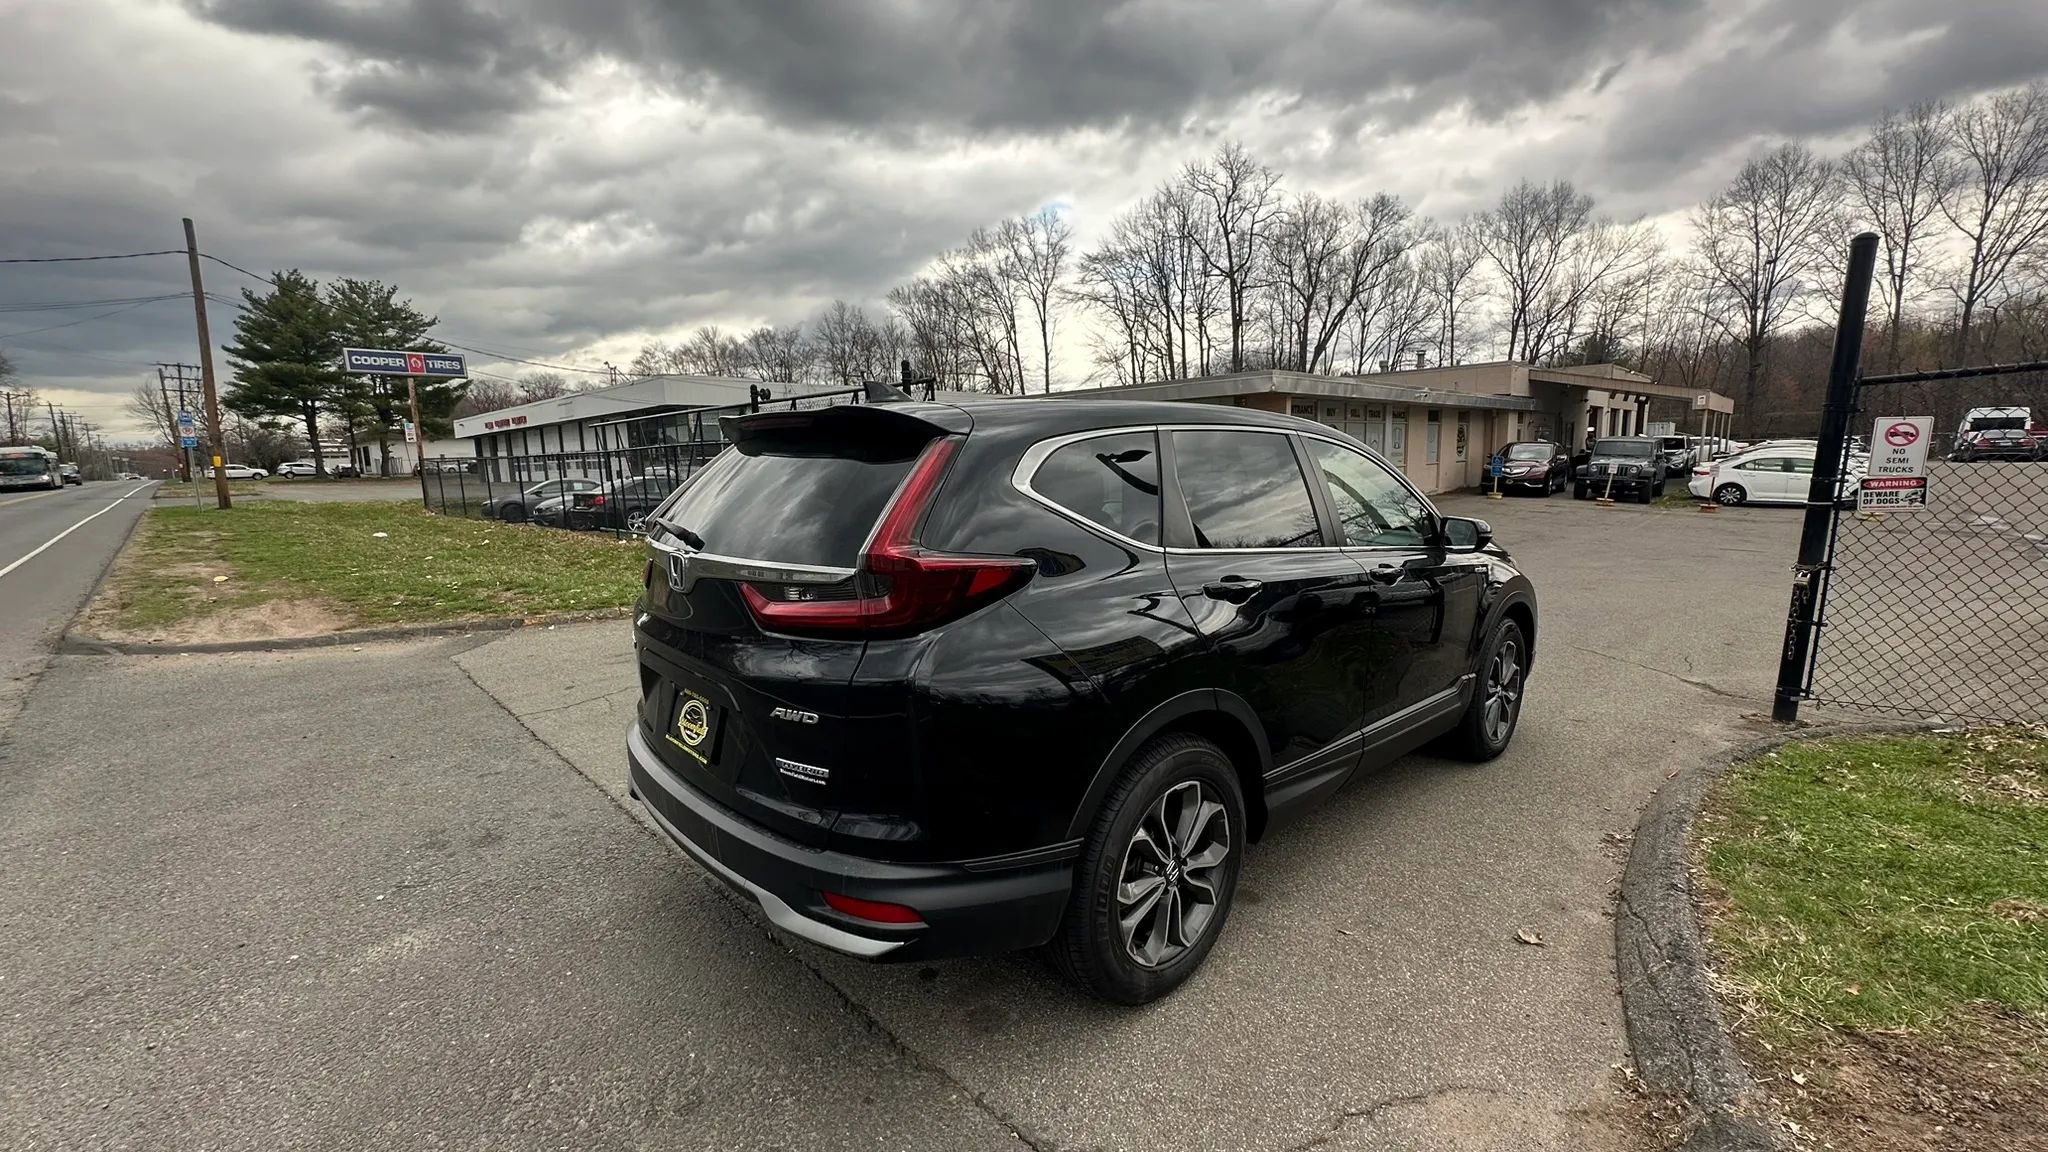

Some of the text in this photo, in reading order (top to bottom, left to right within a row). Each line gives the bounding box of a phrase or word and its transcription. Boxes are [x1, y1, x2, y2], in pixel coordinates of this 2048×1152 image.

[351, 355, 460, 370] COOPER TIRES
[1869, 480, 1917, 488] WARNING
[769, 707, 819, 725] AWD
